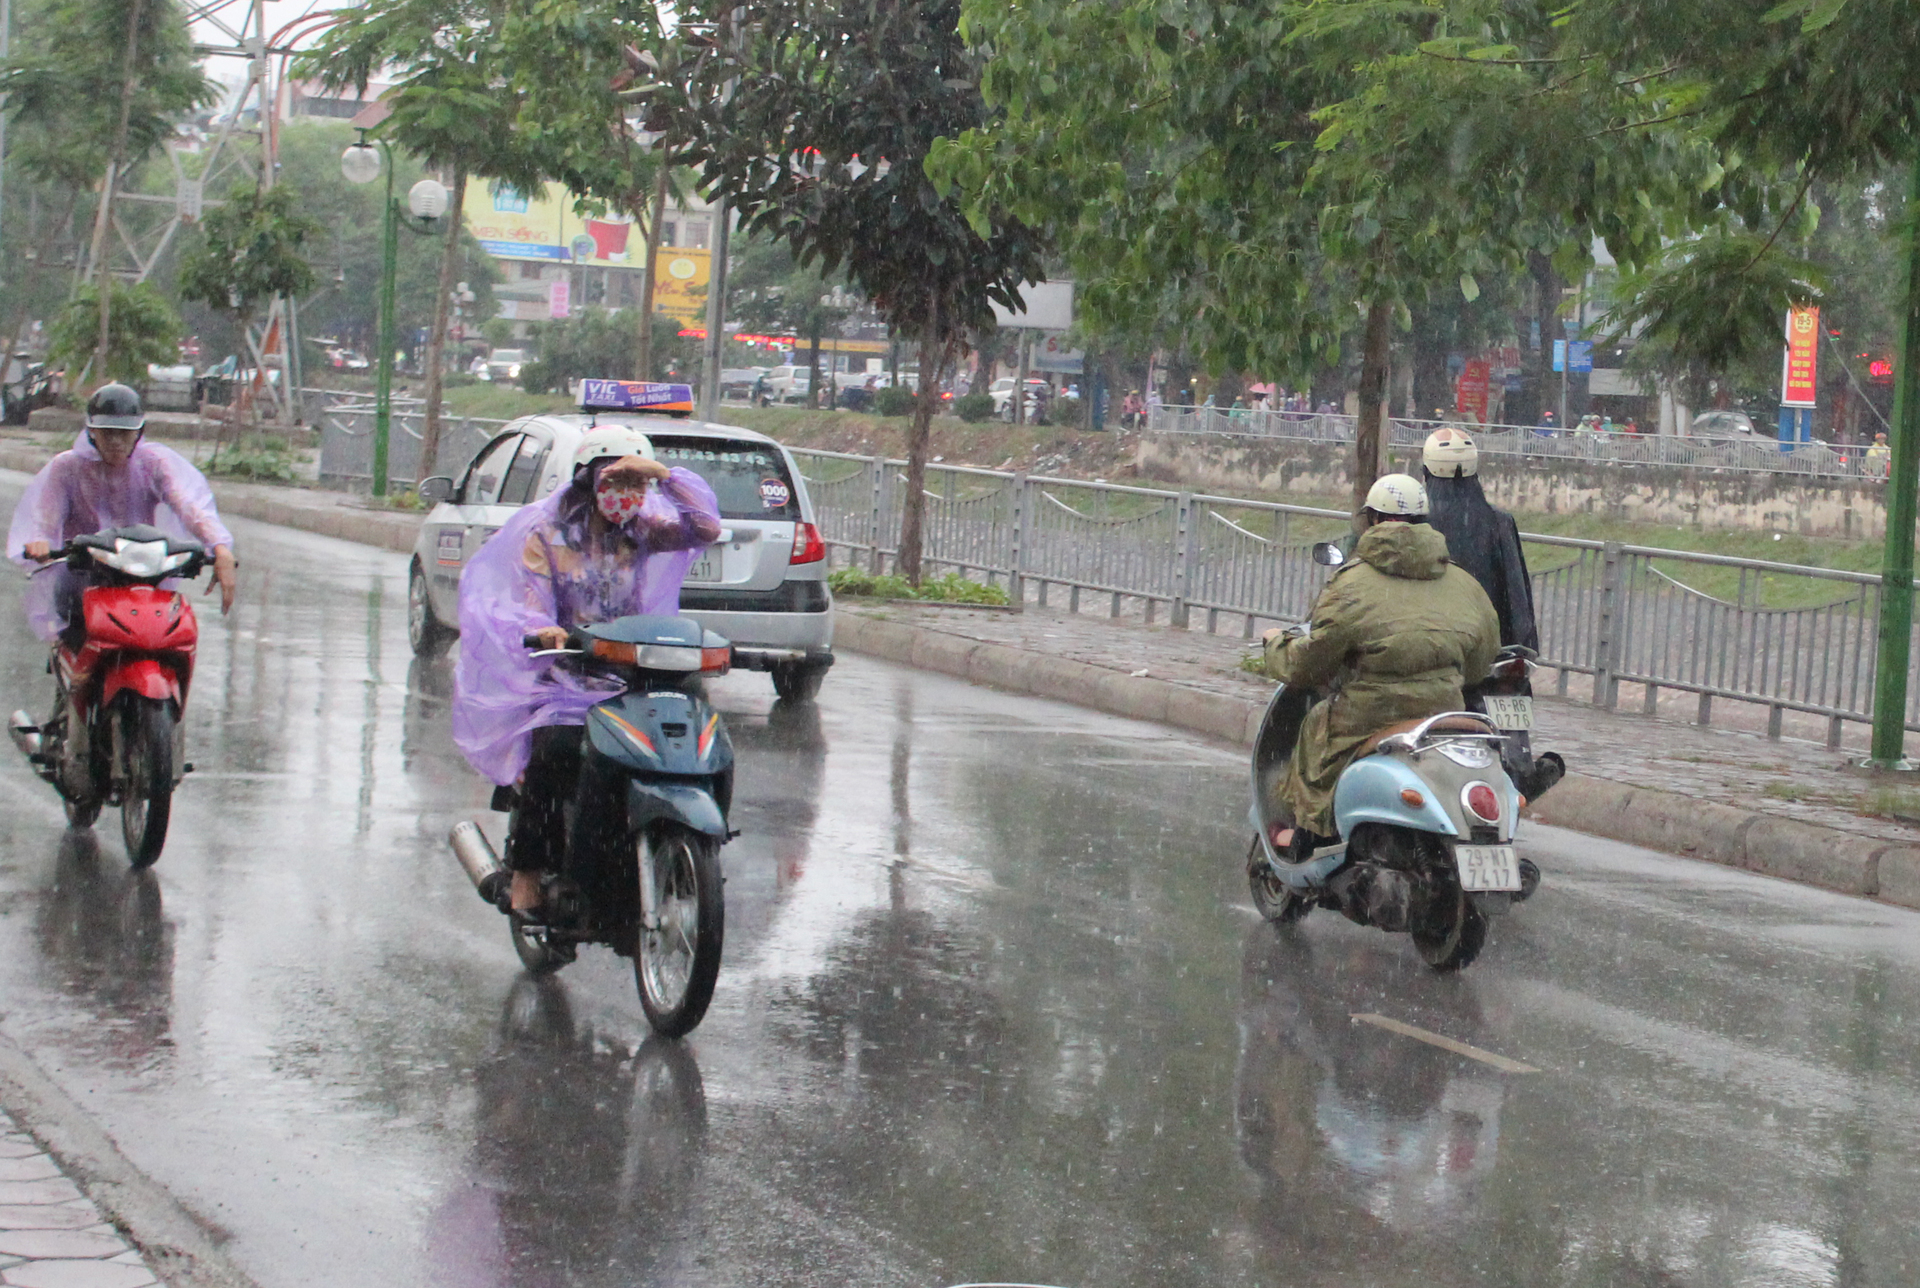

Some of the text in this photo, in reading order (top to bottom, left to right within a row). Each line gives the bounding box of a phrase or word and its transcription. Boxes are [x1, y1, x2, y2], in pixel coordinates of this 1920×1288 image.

[589, 382, 618, 395] VIC
[761, 484, 788, 497] 1000
[1493, 699, 1527, 713] 16-R6
[1495, 714, 1530, 728] 0276
[1468, 868, 1510, 888] 7417
